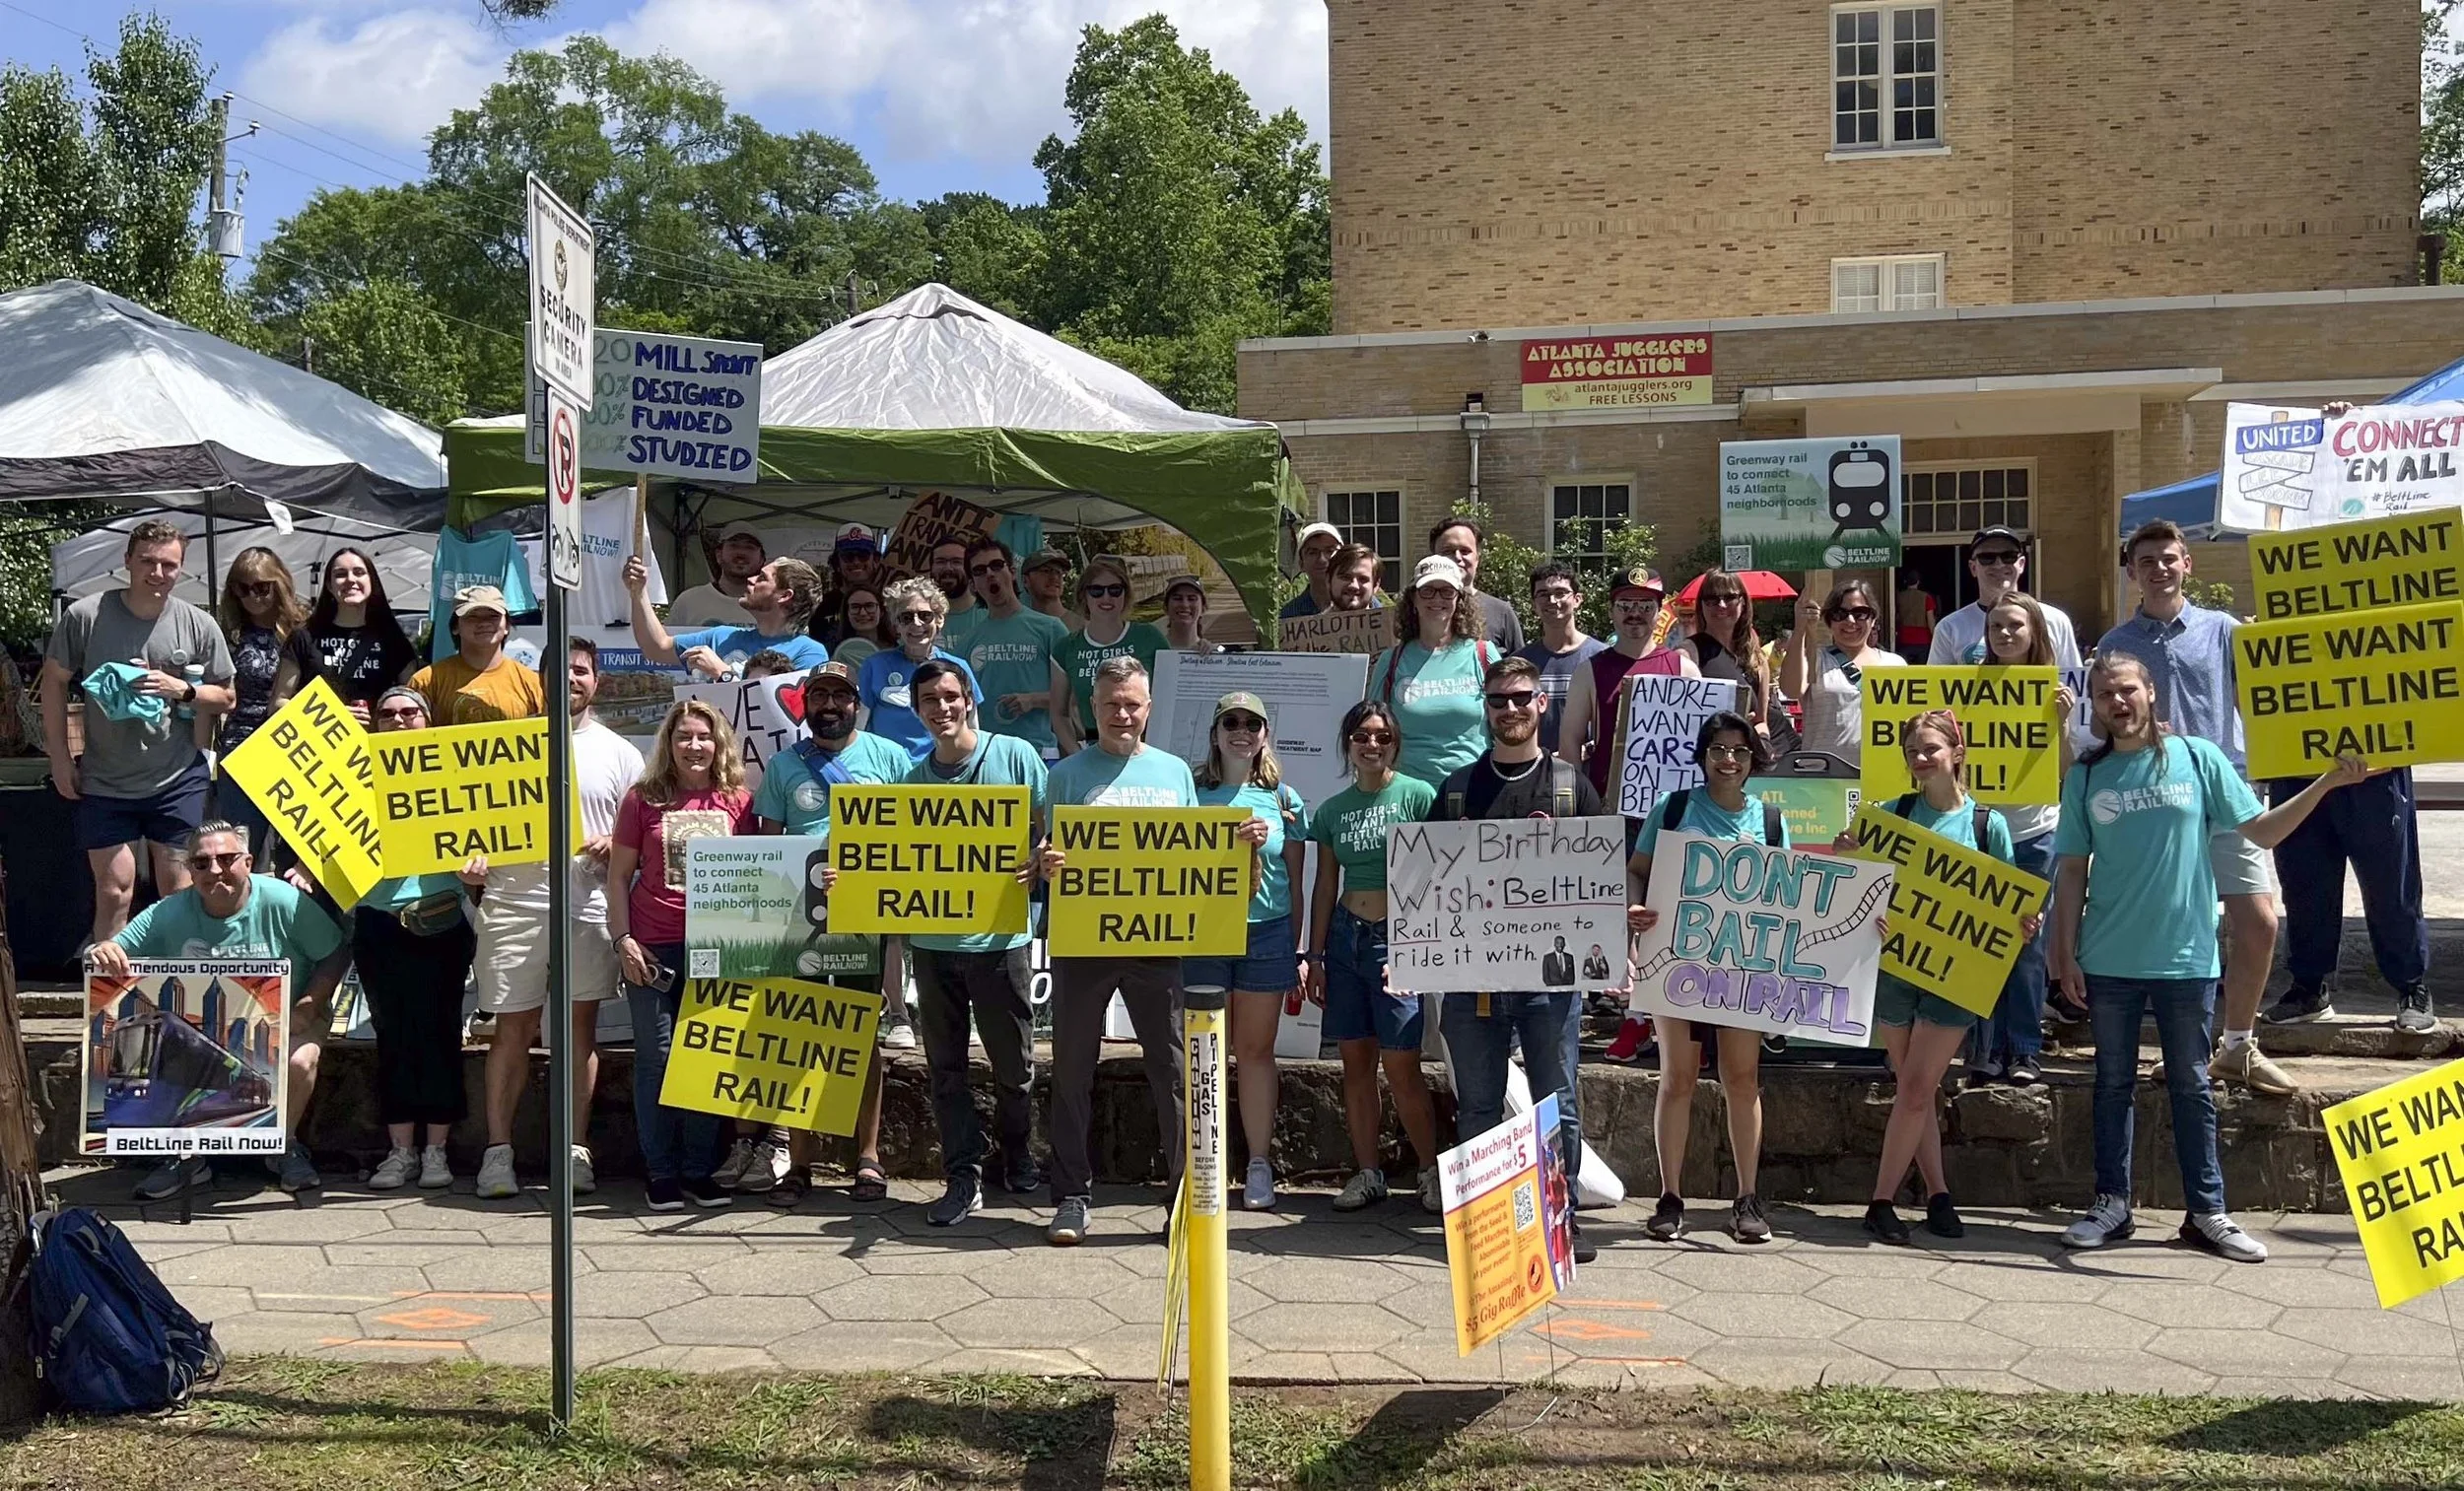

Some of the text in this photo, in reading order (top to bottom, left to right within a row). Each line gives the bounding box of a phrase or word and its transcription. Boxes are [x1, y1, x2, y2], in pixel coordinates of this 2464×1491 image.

[540, 284, 586, 341] SECURITY
[544, 319, 582, 371] CAMERA
[636, 342, 698, 373] MILL
[1527, 338, 1707, 362] ATLANTA JUGGLERS
[1548, 357, 1686, 378] ASSOCIATION
[632, 376, 745, 409] DESIGNED
[1574, 378, 1692, 394] atlantajugglers.org
[1589, 392, 1677, 405] FREE LESSONS
[632, 405, 732, 435] FUNDED
[2242, 425, 2316, 450] UNITED
[2333, 416, 2464, 457] CONNECT
[626, 436, 752, 472] STUDIED
[1727, 453, 1808, 467] Greenway rail
[2396, 452, 2456, 482] ALL
[1727, 468, 1790, 480] to connect
[1727, 483, 1787, 495] 45 Atlanta
[1727, 496, 1817, 510] neighborhoods
[915, 493, 995, 532] ANTI
[2385, 502, 2408, 511] Rail
[1847, 547, 1890, 556] BELTLINE
[2258, 522, 2452, 576] WE WANT
[2266, 567, 2460, 619] BELTLINE
[320, 638, 345, 647] HOT
[988, 644, 1038, 653] BELTLINE
[1077, 644, 1134, 659] HOT GIRLS
[1338, 634, 1389, 653] RAIL
[2243, 617, 2454, 669] WE WANT
[603, 653, 643, 666] TRANSIT
[1632, 677, 1724, 710] ANDRE
[1871, 679, 1928, 706] WE
[1940, 679, 2049, 707] WANT
[2250, 666, 2460, 717] BELTLINE
[302, 692, 350, 750] WE
[1872, 721, 2048, 749] BLINE
[1627, 737, 1696, 766] CARS
[2302, 720, 2416, 760] RAIL!
[378, 744, 443, 777] WE
[1624, 763, 1660, 790] ON
[270, 719, 382, 867] BELTLINE
[387, 777, 549, 820] BELTLIN
[1761, 790, 1787, 803] ATL
[2123, 781, 2194, 802] BELTLINE
[265, 778, 341, 864] RAIL!
[838, 796, 1019, 827] WE WANT
[1340, 803, 1398, 824] HOT GIRLS
[1351, 816, 1385, 831] WANT
[435, 822, 533, 859] RAIL!
[1060, 821, 1239, 850] WE WANT
[1340, 826, 1386, 844] BELTLIN
[1353, 838, 1381, 852] RAIL
[694, 850, 783, 864] Greenway rail
[838, 843, 1016, 873] BELTLINE
[1391, 822, 1623, 879] My Birthday
[694, 866, 763, 878] to connect
[1858, 818, 2034, 915] WE WANT
[693, 882, 760, 894] 45 Atlanta
[1060, 867, 1238, 896] BELTLINE
[1391, 875, 1623, 914] Wish: BeltLine
[694, 897, 792, 912] neighborhoods
[877, 889, 974, 918] RAIL!
[1099, 913, 1196, 942] RAIL!
[1394, 915, 1594, 940] Rail & someone to
[1889, 882, 2014, 960] LTLINE
[1673, 901, 1826, 979] BAIL
[200, 963, 289, 976] Opportunity
[823, 953, 868, 962] BELTLINE
[1395, 944, 1472, 968] ride it
[1881, 932, 1954, 983] AIL!
[695, 979, 871, 1034] WE WANT
[1664, 963, 1867, 1037] ON RAIL
[683, 1021, 861, 1078] BELTLINE
[714, 1072, 811, 1115] RAIL!
[1191, 1038, 1200, 1149] CAUTION
[1201, 1072, 1210, 1116] GAS
[116, 1137, 283, 1151] BeltLine Rail Now!
[1448, 1117, 1533, 1176] Win a Marching Band
[2336, 1108, 2399, 1161] WE
[1455, 1143, 1527, 1196] Performance for $5
[1466, 1284, 1526, 1332] $5 Gig Raffle
